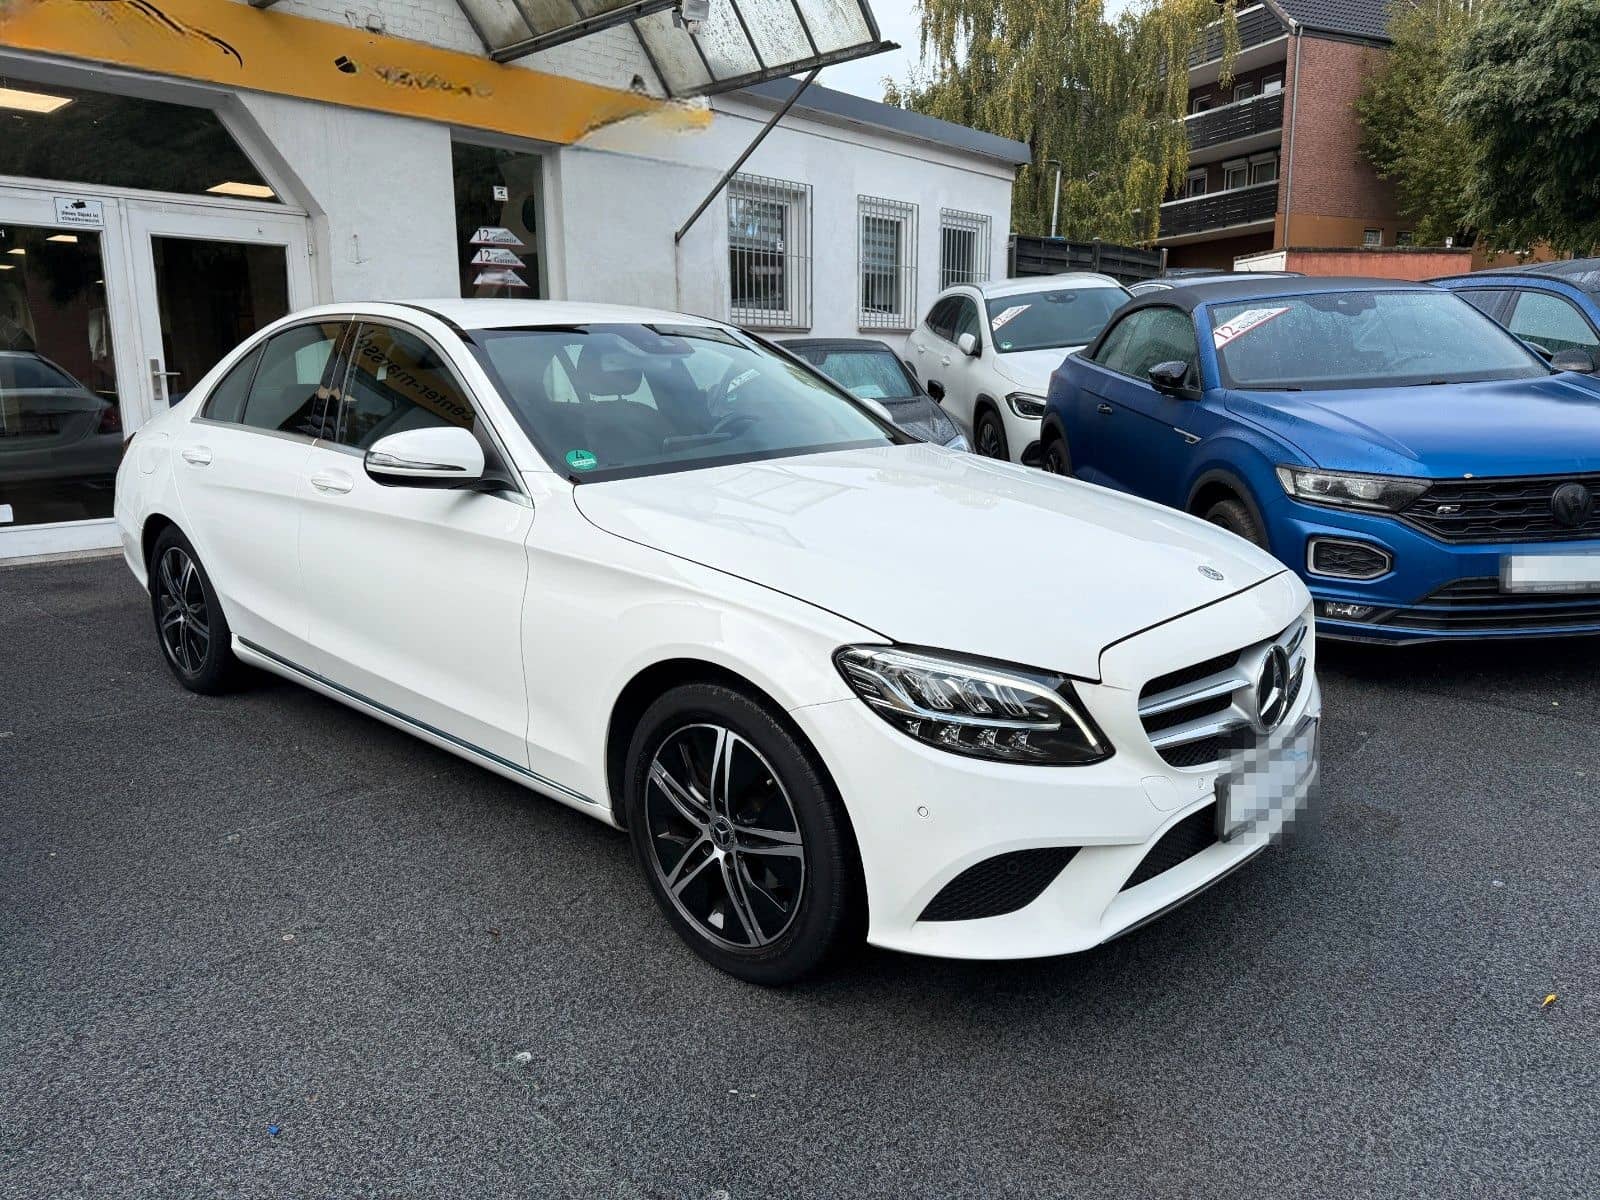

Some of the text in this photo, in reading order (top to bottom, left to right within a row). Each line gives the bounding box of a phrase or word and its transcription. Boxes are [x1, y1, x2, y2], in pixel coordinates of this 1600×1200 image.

[478, 229, 490, 242] 12
[479, 249, 492, 262] 12
[1214, 326, 1241, 340] 12
[575, 450, 585, 460] 4
